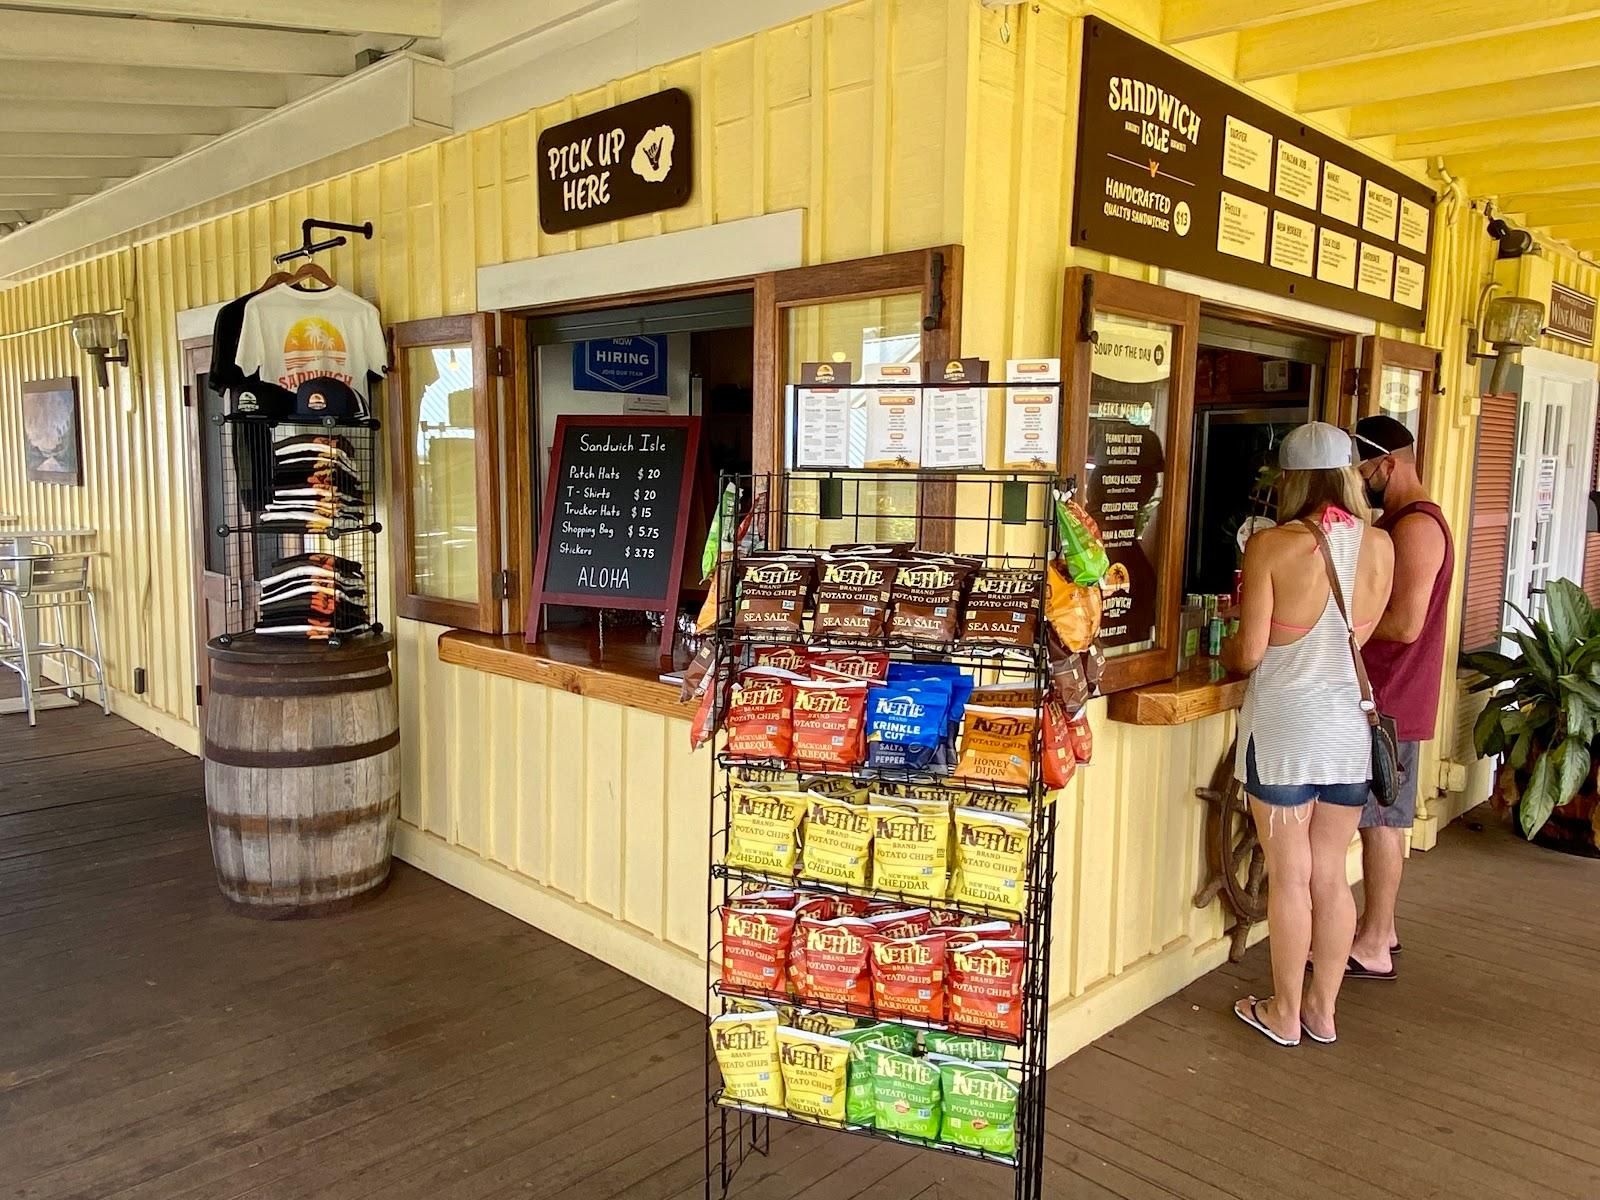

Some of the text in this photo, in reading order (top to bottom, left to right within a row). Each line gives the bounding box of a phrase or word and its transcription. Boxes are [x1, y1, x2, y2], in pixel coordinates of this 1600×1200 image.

[1108, 76, 1201, 145] SANDWICH
[1141, 120, 1170, 153] ISLE
[548, 128, 626, 180] PICK UP
[563, 171, 611, 212] HERE
[1105, 176, 1171, 215] HANDCRAFTED
[1104, 202, 1171, 233] QUALITY SANDWICHES
[1176, 210, 1188, 226] $13
[613, 338, 632, 346] NOW
[596, 350, 649, 365] HIRING
[1094, 343, 1112, 356] SOUP
[1114, 344, 1124, 358] OF
[1125, 345, 1138, 360] THE
[1139, 348, 1152, 361] DAY
[580, 433, 666, 452] Sandwich Isle
[569, 465, 595, 479] Patch
[598, 467, 620, 480] Hats
[564, 502, 598, 516] Trucker
[600, 505, 621, 517] Hats
[562, 521, 596, 538] Shopping
[599, 523, 614, 538] Bag
[559, 542, 592, 556] Stickers
[577, 566, 630, 589] ALOHA
[742, 563, 803, 584] KETTLE
[823, 562, 885, 586] KETTLE
[893, 565, 955, 589] KETTLE
[773, 589, 797, 597] CHIPS
[970, 577, 1035, 594] KETTLE
[821, 592, 878, 602] POTATO CHIPS
[892, 593, 924, 602] POTATO
[968, 600, 1028, 609] POTATO CHIPS
[1103, 597, 1132, 612] ANDWICH
[744, 613, 789, 622] SEA SALT
[823, 617, 870, 628] SEA SALT
[892, 617, 941, 630] SEA SALT
[968, 622, 1020, 634] SEA SALT
[825, 655, 880, 677] KETTLE
[730, 685, 784, 709] KETTLE
[794, 689, 851, 713] KETTLE
[876, 695, 925, 718] KETTLE
[730, 713, 780, 722] POTATO CHIPS
[823, 721, 846, 730] CHIPS
[873, 720, 921, 735] KRINKLE
[972, 717, 1034, 737] KETTLE
[884, 732, 904, 741] CUT
[969, 738, 1027, 750] POTATO CHIPS
[797, 742, 832, 750] BACKYARD
[879, 743, 898, 751] SALT
[875, 755, 905, 765] PEPPER
[975, 757, 1010, 769] HONEY
[975, 766, 1006, 776] DIJON
[738, 794, 796, 822] KETTLE
[808, 803, 870, 833] KETTLE
[735, 825, 790, 840] POTATO CHIPS
[826, 829, 849, 837] BRAND
[875, 815, 936, 842] KETTLE
[808, 835, 839, 846] POTATO
[960, 822, 1024, 855] KETTLE
[735, 854, 783, 868] CHEDDAR
[877, 850, 934, 861] POTATO CHIPS
[976, 850, 1001, 859] BRAND
[808, 861, 856, 879] CHEDDAR
[992, 862, 1018, 874] CHIPS
[878, 877, 929, 890] CHEDDAR
[726, 913, 780, 945] KETTLE
[742, 940, 763, 948] BRAND
[807, 927, 864, 955] KETTLE
[725, 947, 754, 957] POTATO
[823, 954, 845, 962] BRAND
[873, 941, 933, 966] KETTLE
[838, 965, 860, 974] CHIPS
[954, 949, 1013, 978] KETTLE
[908, 975, 931, 984] CHIPS
[971, 976, 995, 984] BRAND
[953, 982, 1011, 997] POTATO CHIPS
[884, 994, 920, 1004] BACKYARD
[961, 1007, 999, 1018] BACKYARD
[716, 1023, 769, 1050] KETTLE
[746, 1060, 769, 1068] CHIPS
[781, 1042, 834, 1073] KETTLE
[875, 1053, 934, 1085] KETTLE
[811, 1080, 833, 1090] CHIPS
[893, 1081, 915, 1089] BRAND
[950, 1069, 1018, 1103] KETTLE
[875, 1087, 930, 1103] POTATO CHIPS
[951, 1105, 984, 1117] POTATO
[970, 1100, 995, 1108] BRAND
